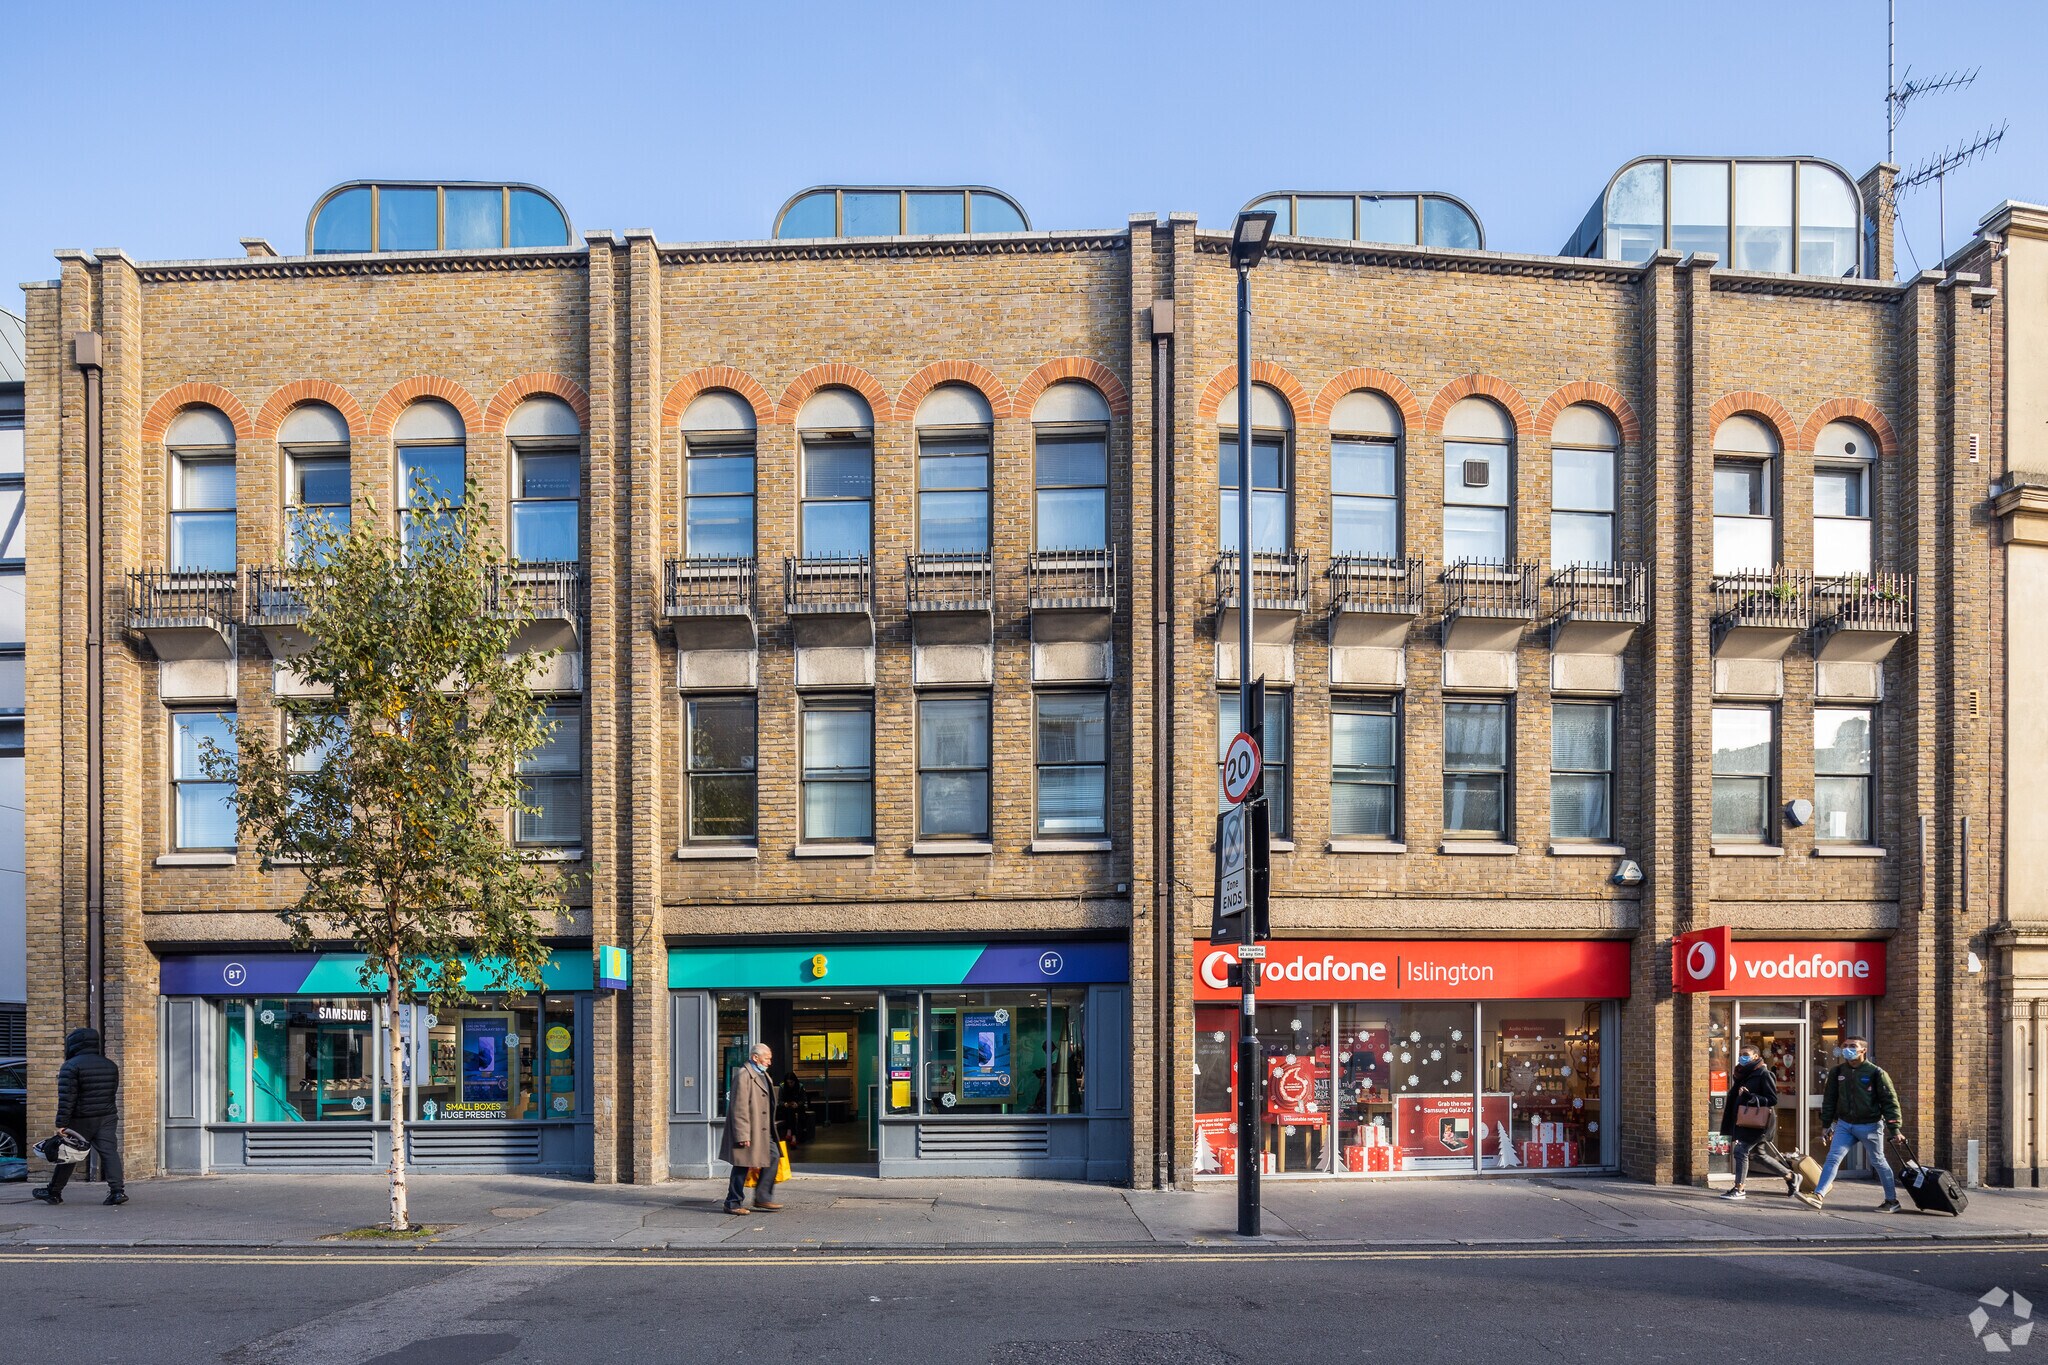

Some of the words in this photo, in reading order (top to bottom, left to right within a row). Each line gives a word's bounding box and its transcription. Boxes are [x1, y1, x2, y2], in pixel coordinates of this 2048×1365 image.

[1228, 751, 1250, 787] 20
[1226, 880, 1239, 891] Zone
[1223, 891, 1242, 909] ENDS
[1045, 959, 1058, 968] BT
[1743, 953, 1869, 978] vodafone
[228, 970, 242, 979] BT
[1408, 961, 1494, 986] Islington
[318, 1007, 367, 1022] SAMSUNG
[931, 1017, 956, 1025] DISCO
